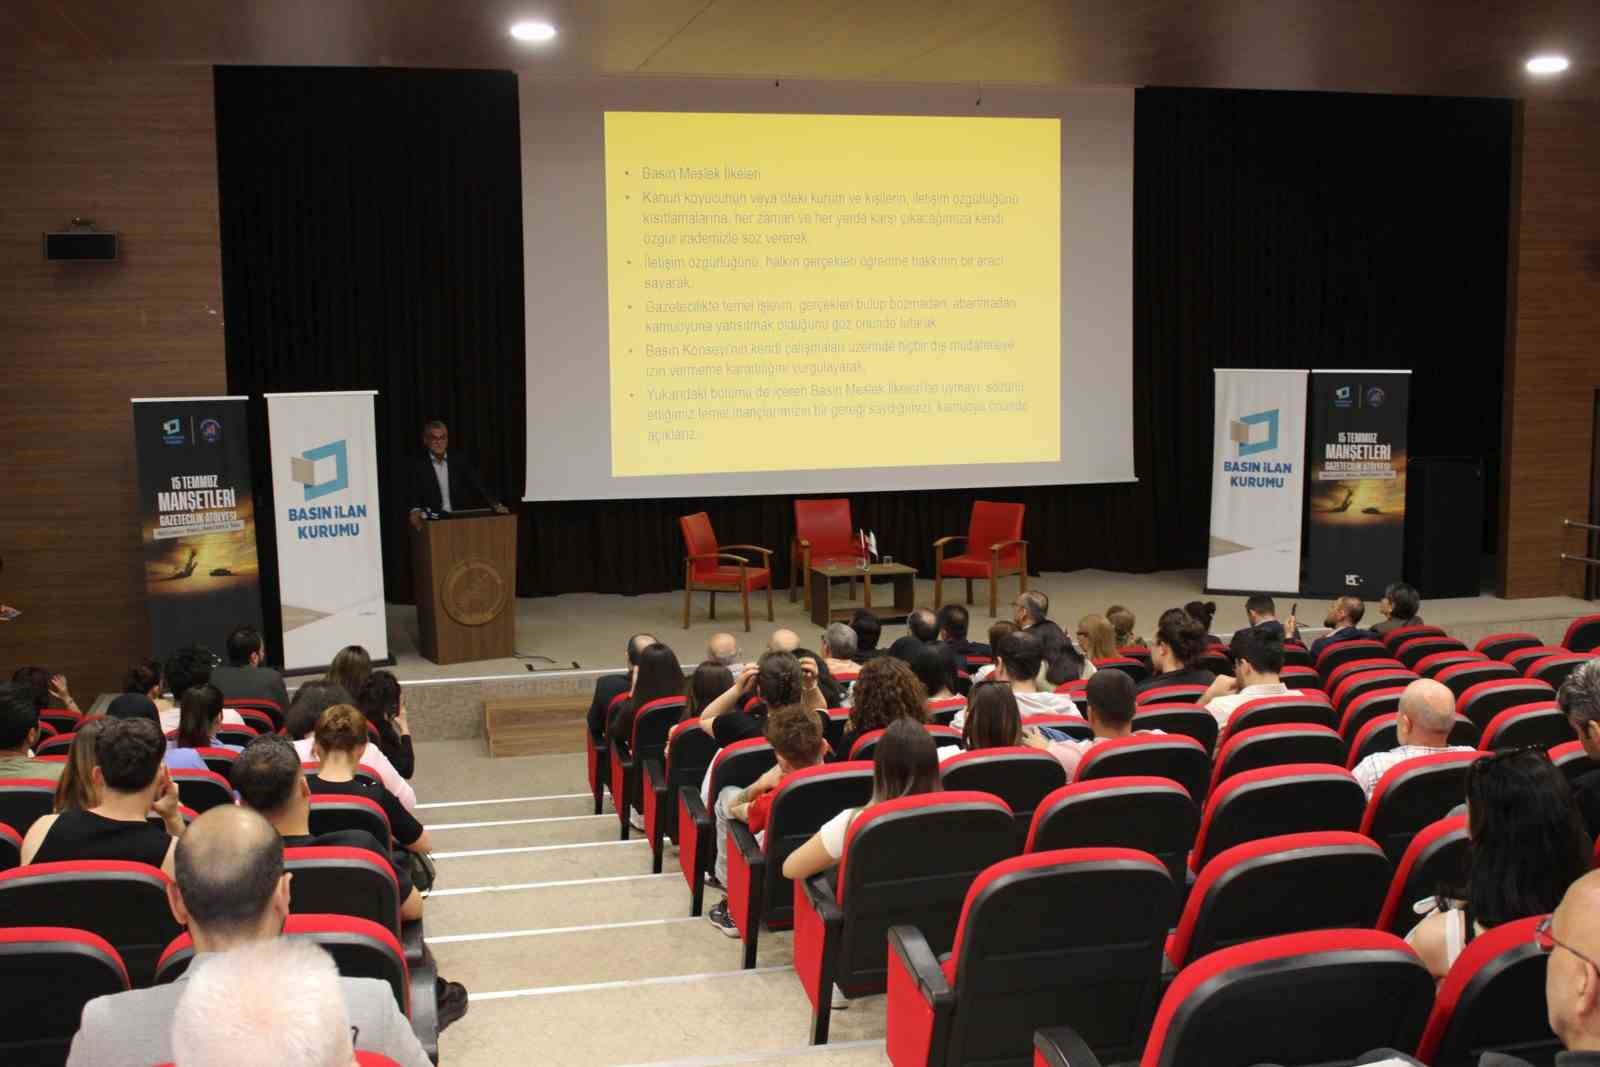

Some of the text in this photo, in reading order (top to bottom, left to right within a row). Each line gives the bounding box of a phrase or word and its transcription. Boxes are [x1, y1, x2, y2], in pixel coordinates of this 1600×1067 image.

[1325, 443, 1392, 461] MANŞETLERİ
[1224, 461, 1262, 474] BASIN
[171, 474, 219, 490] 15 TEMMUZ
[1230, 475, 1284, 489] KURUMU
[157, 486, 237, 512] MANŞETLERİ
[288, 505, 332, 522] BASIN
[298, 522, 360, 540] KURUMU
